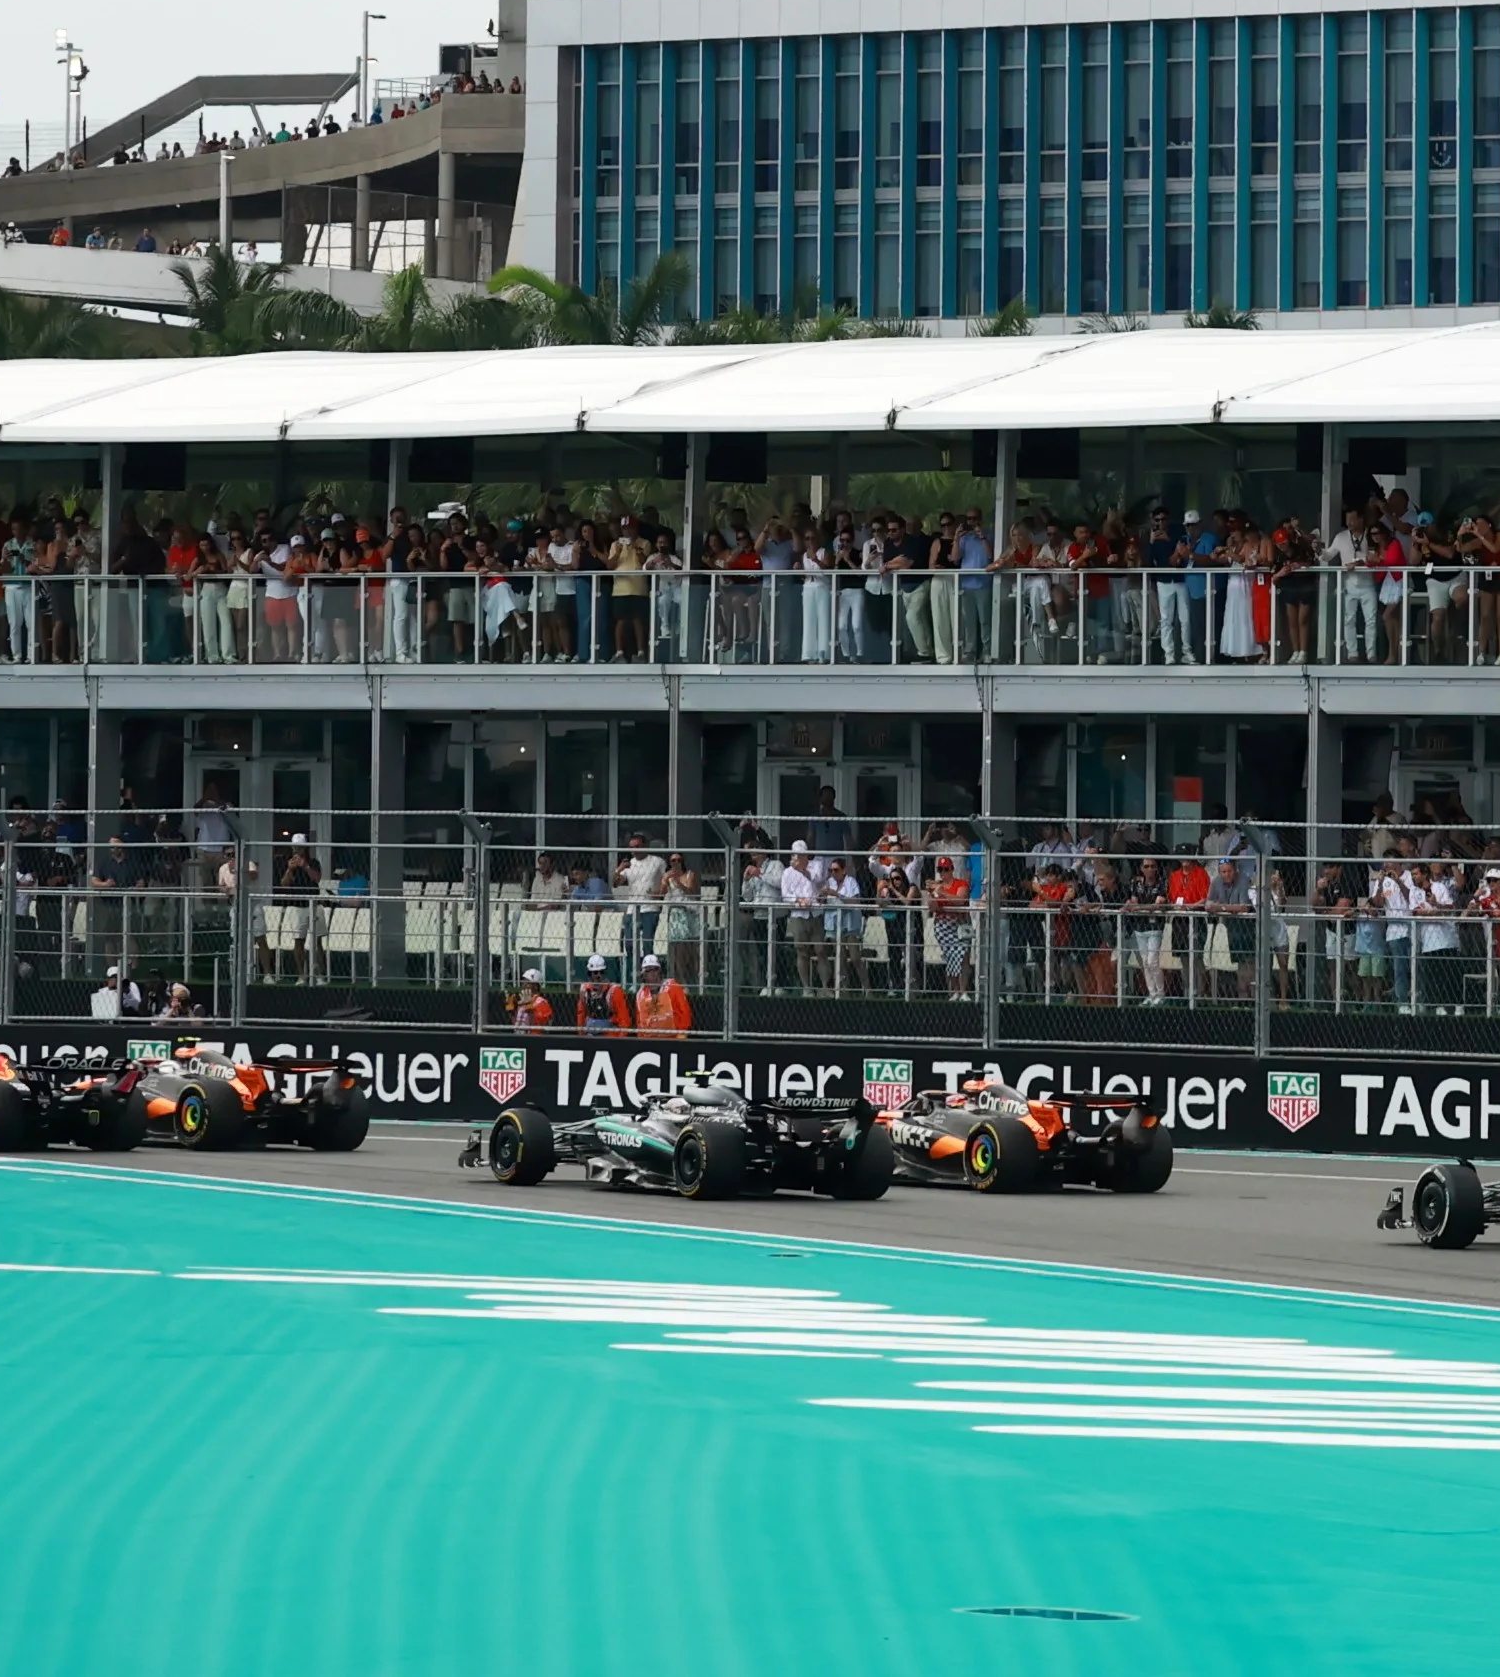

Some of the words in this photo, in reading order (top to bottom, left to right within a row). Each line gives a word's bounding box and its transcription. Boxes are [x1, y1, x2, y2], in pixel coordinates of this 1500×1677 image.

[130, 1042, 170, 1060] TAG
[484, 1051, 523, 1069] TAG
[46, 1057, 125, 1071] ORACLE
[867, 1062, 909, 1081] TAG
[481, 1072, 524, 1102] HEUER
[1272, 1076, 1316, 1096] TAG
[776, 1096, 859, 1109] CROWDSTRIKE
[1270, 1099, 1319, 1128] HEUER
